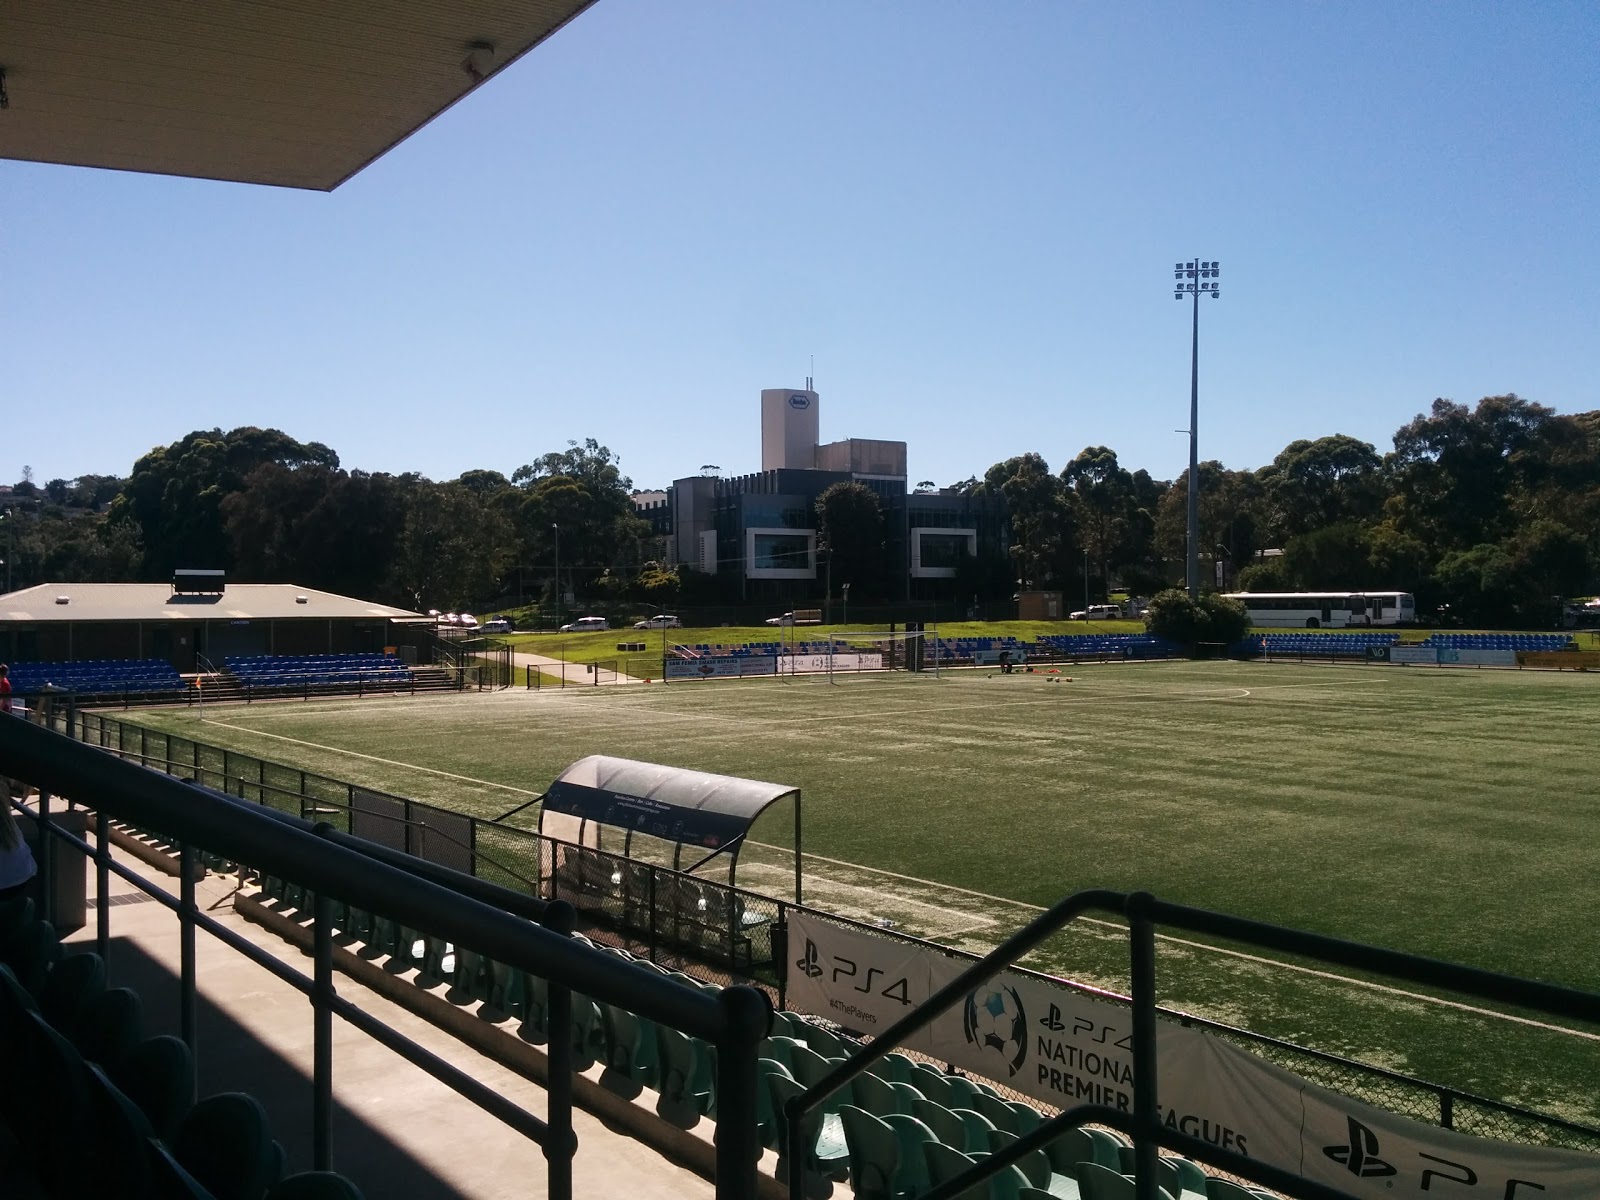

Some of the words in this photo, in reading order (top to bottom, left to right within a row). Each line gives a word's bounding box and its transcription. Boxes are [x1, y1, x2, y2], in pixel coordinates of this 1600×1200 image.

[833, 955, 912, 1006] PS4
[829, 998, 877, 1024] #4ThePlayers
[1038, 1035, 1134, 1088] NATIONA
